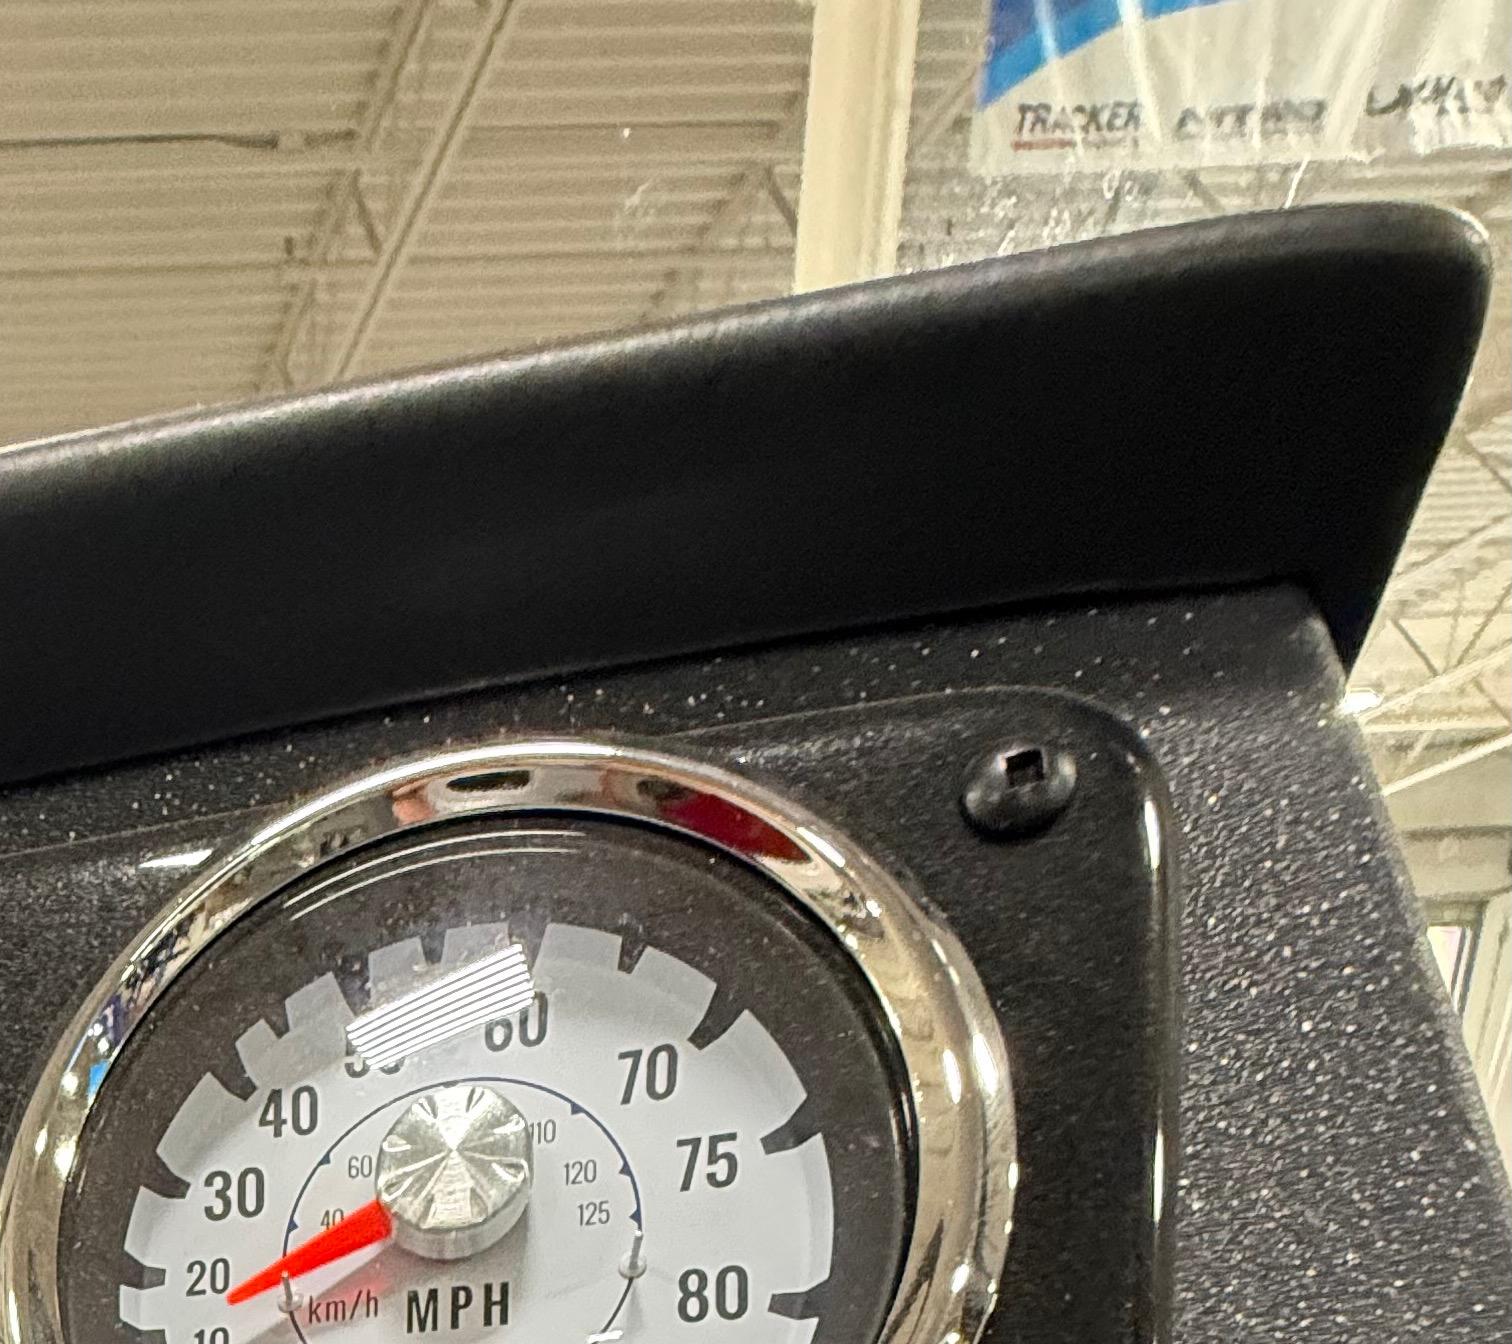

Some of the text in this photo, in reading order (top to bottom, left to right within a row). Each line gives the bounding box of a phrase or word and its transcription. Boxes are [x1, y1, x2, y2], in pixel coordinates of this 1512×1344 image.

[484, 991, 549, 1052] 60
[617, 1043, 680, 1105] 70
[258, 1085, 319, 1139] 40
[347, 1154, 373, 1179] 60
[564, 1158, 598, 1186] 120
[677, 1132, 740, 1192] 75
[203, 1165, 266, 1221] 30
[578, 1200, 611, 1228] 125
[186, 1258, 232, 1298] 20
[677, 1264, 750, 1323] 80
[308, 1289, 381, 1325] km/h
[406, 1281, 512, 1336] MPH
